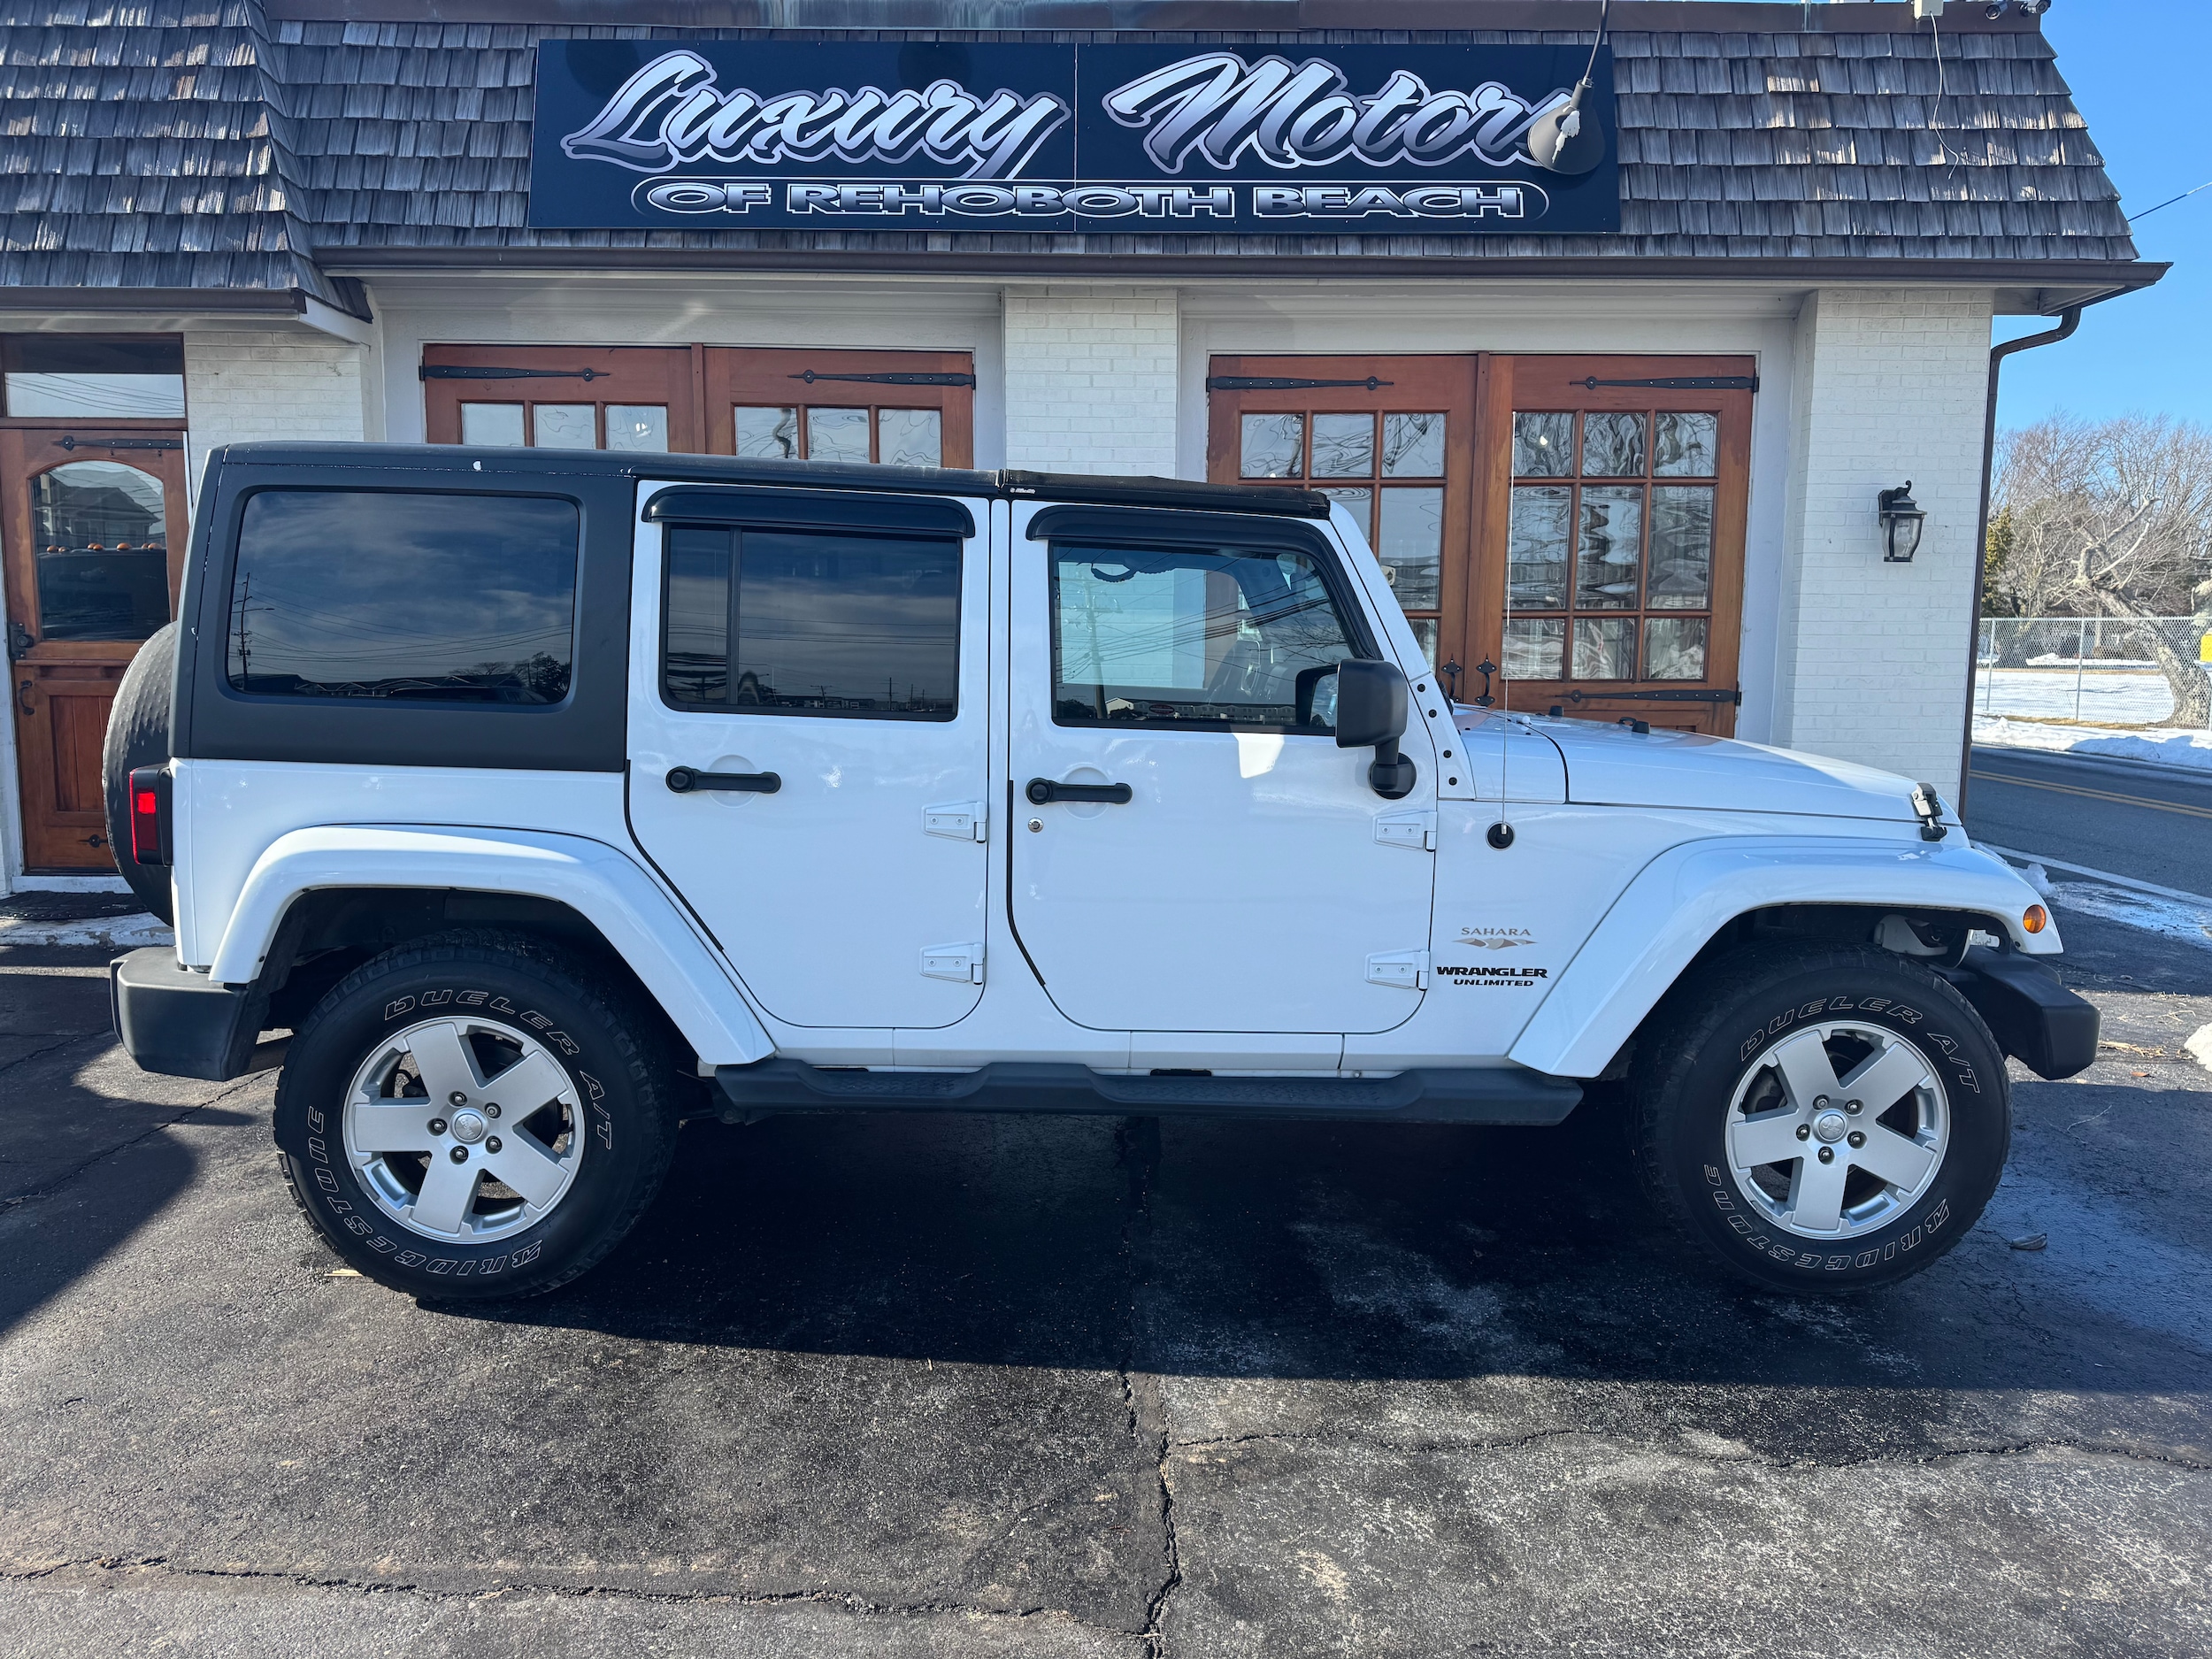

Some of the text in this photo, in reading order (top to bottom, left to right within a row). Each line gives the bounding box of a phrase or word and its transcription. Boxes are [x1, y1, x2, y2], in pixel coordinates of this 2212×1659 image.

[560, 50, 1071, 180] Luxury
[647, 182, 1524, 219] OF REHOBOTH BEACH
[1436, 966, 1548, 979] WRANGLER
[1461, 926, 1532, 936] SAHARA
[384, 989, 612, 1150] DUELER A/T
[1740, 995, 1981, 1094] DUELER A/T
[307, 1105, 542, 1276] BRIDGESTONE
[1703, 1164, 1951, 1271] BRIDGESTONE
